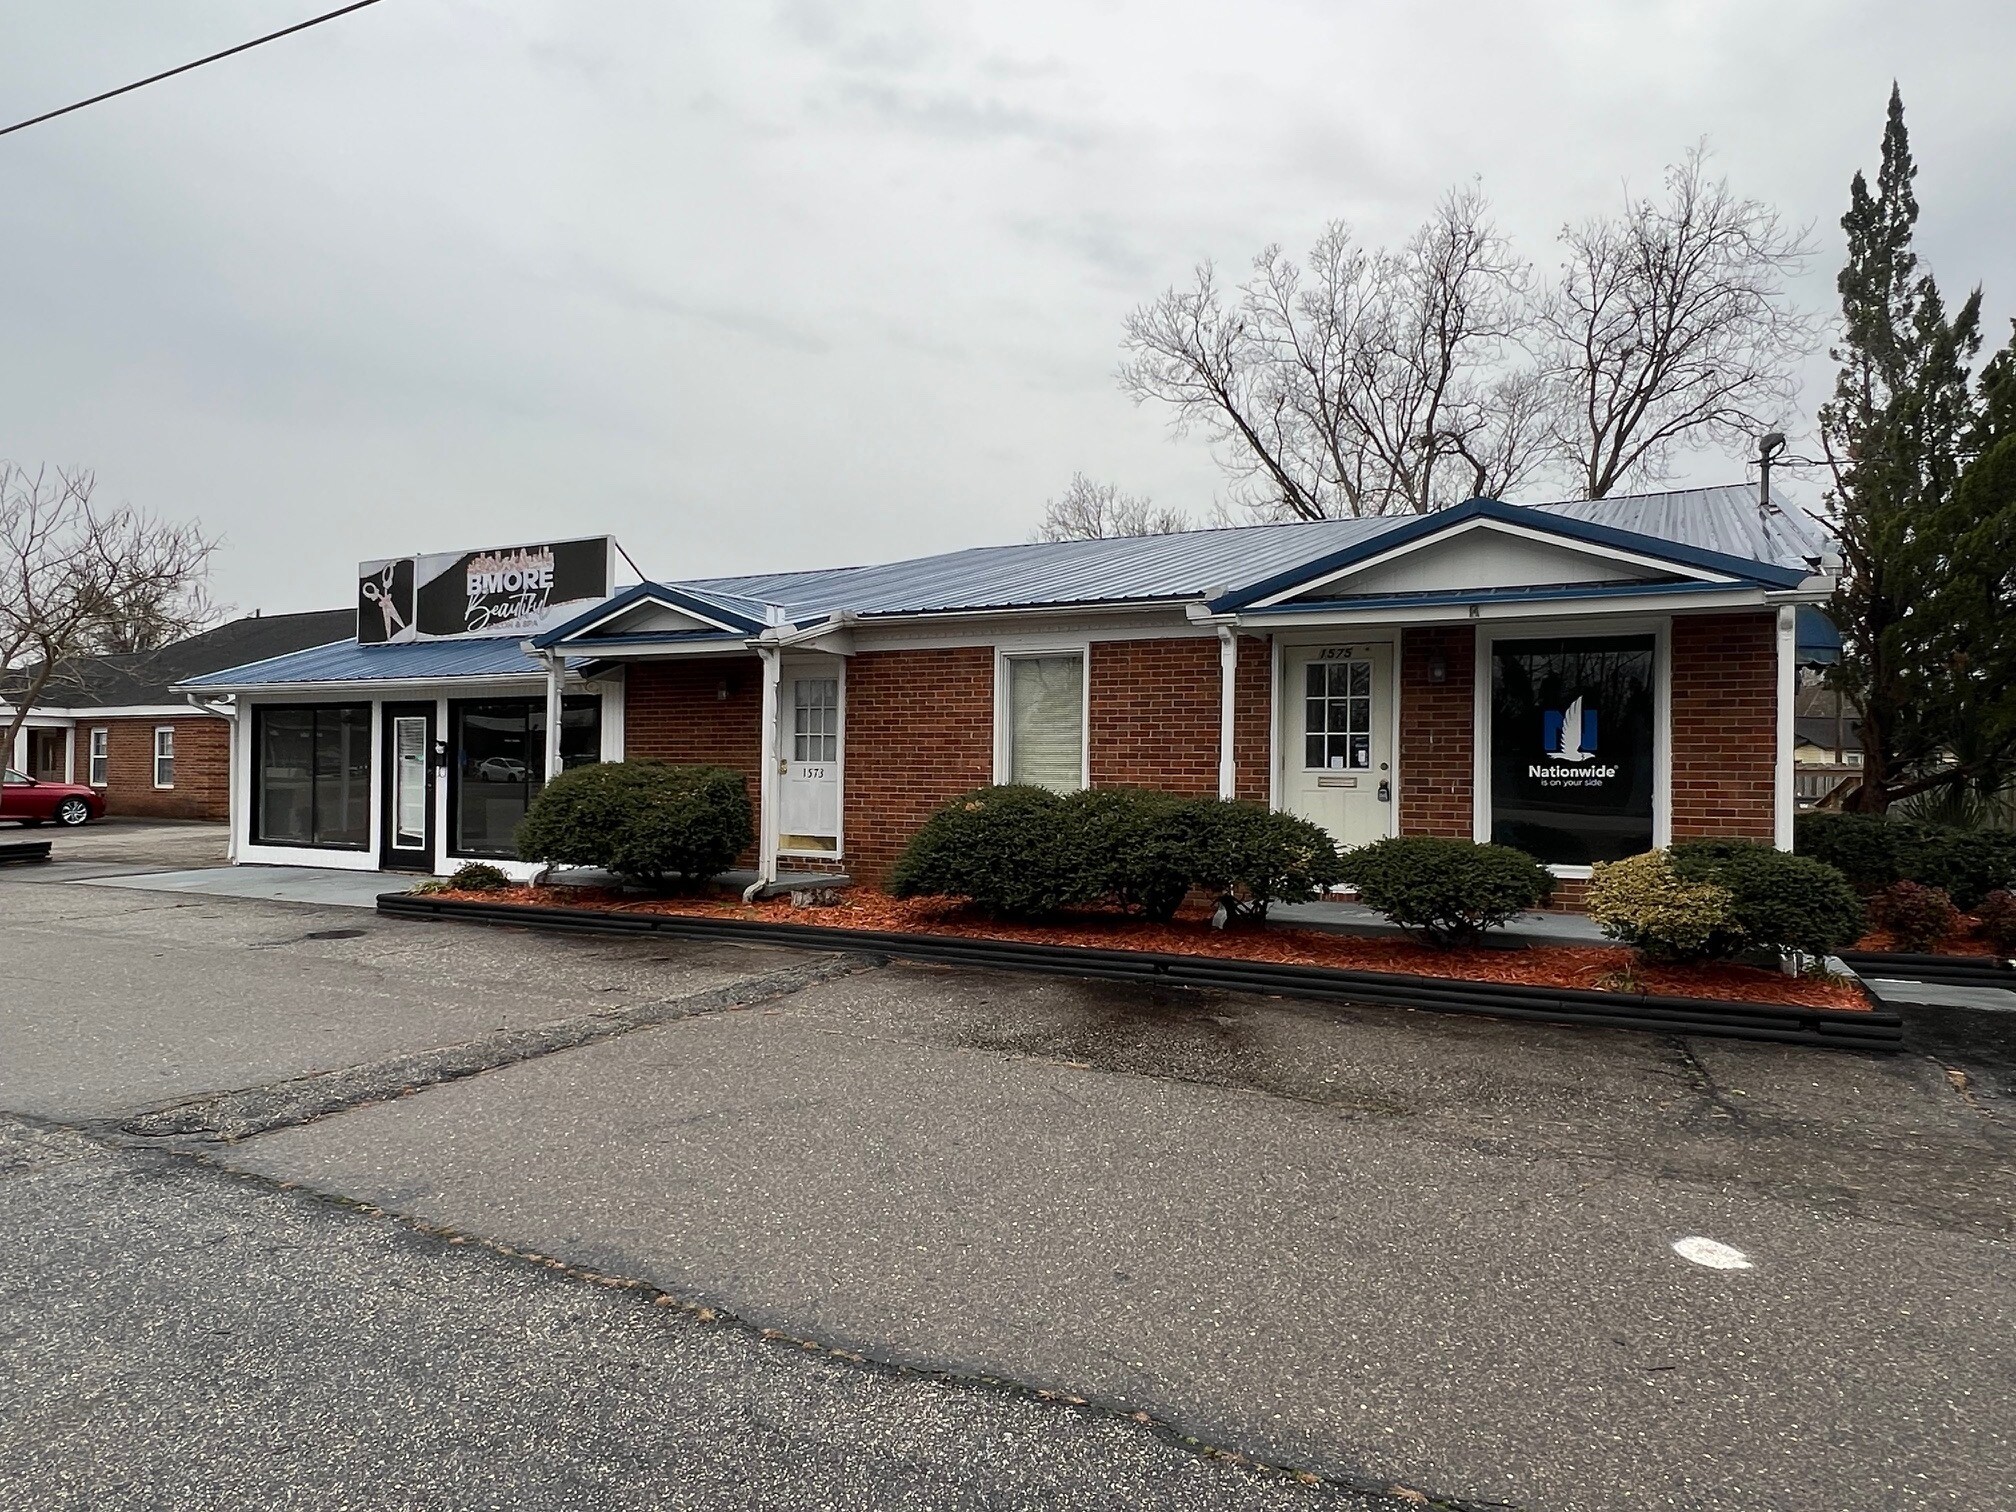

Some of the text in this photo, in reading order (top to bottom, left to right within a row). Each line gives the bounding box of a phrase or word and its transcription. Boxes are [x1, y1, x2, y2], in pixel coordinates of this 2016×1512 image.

[466, 567, 554, 596] BMORE
[464, 586, 550, 632] Beautiful
[1320, 648, 1353, 659] 1575
[803, 768, 824, 779] 1573
[1541, 778, 1548, 786] is
[1584, 778, 1603, 786] side
